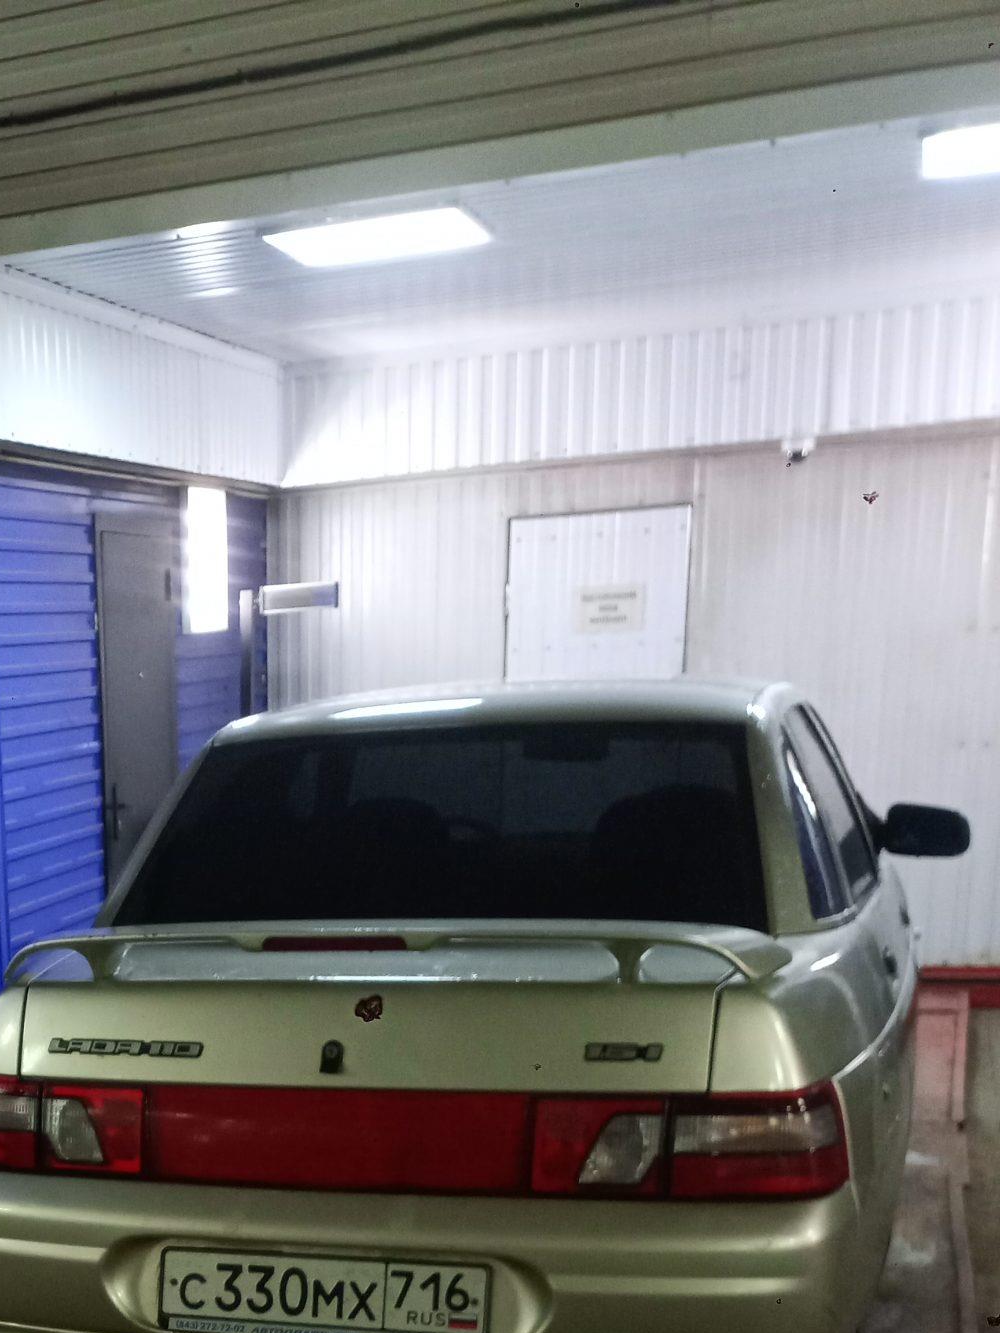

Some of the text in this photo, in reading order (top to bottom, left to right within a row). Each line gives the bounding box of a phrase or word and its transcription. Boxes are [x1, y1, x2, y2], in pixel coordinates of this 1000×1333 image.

[48, 1037, 204, 1058] LADA 110
[390, 1270, 470, 1313] 716
[406, 1310, 446, 1328] RUS
